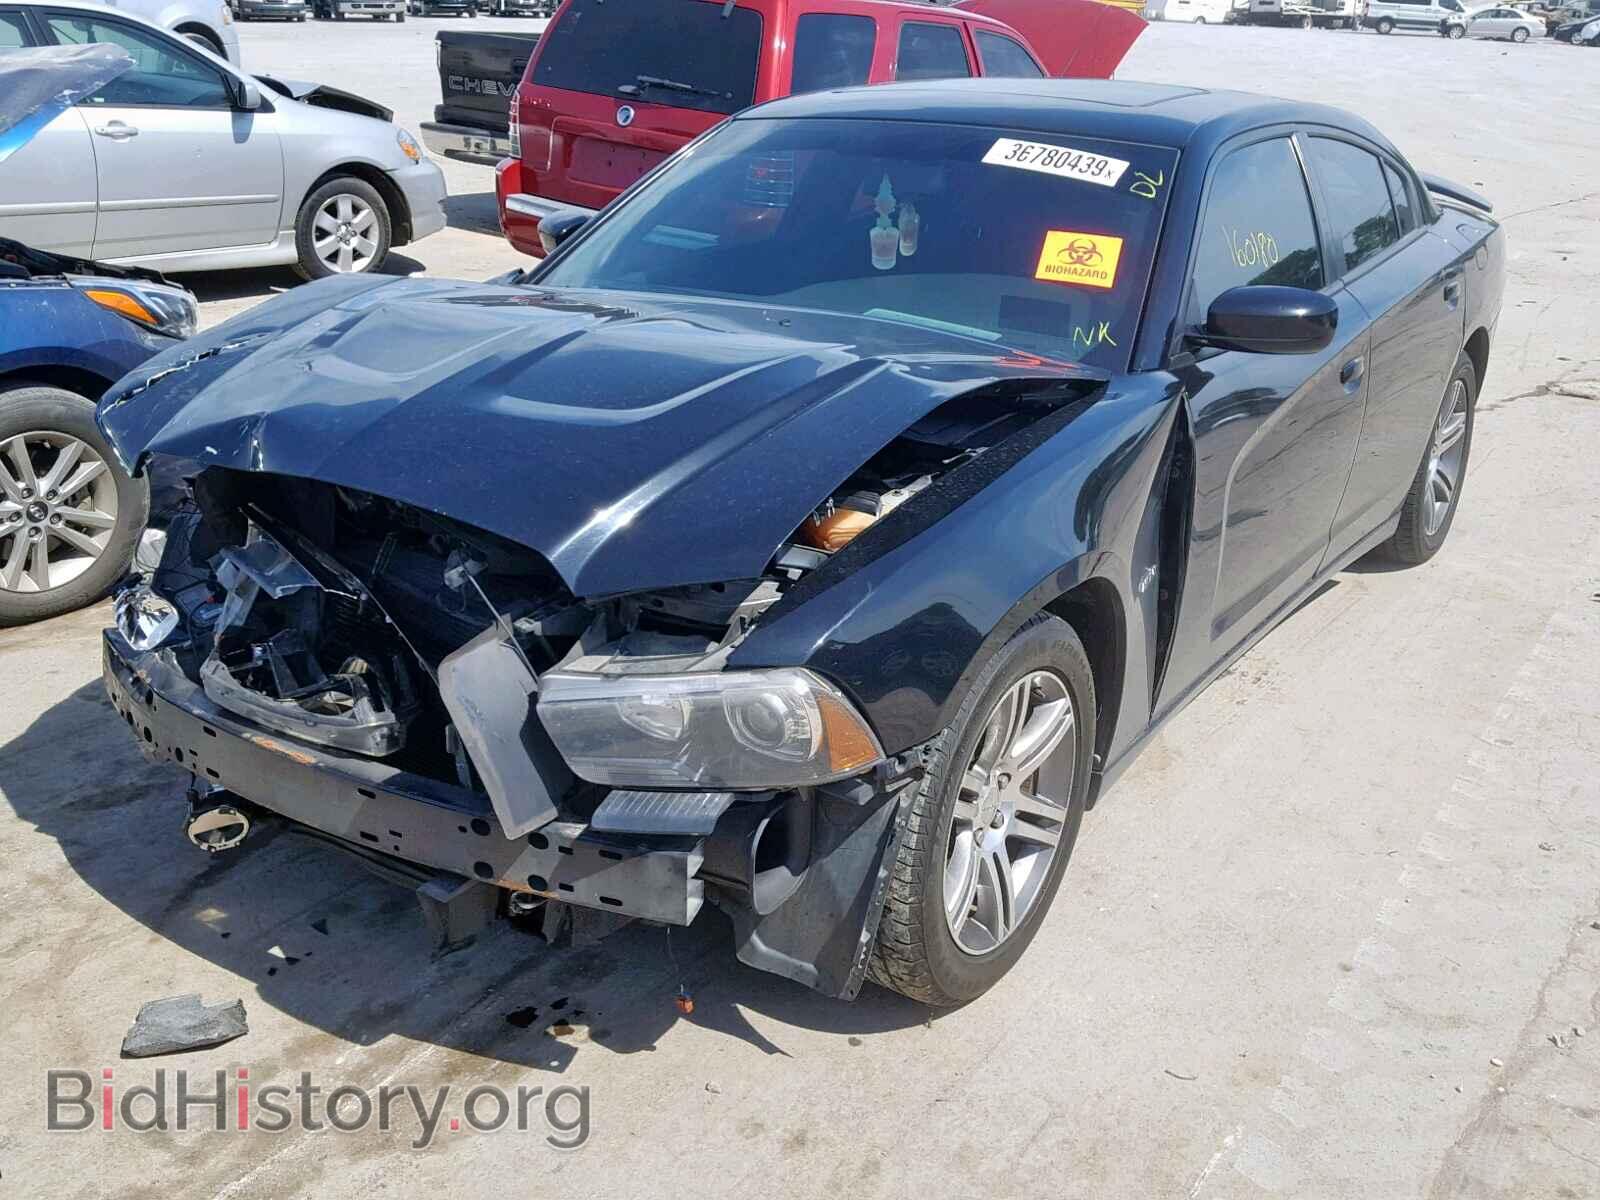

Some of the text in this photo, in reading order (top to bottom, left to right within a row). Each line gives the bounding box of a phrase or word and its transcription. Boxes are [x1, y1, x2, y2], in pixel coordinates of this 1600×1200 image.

[448, 75, 516, 97] CHEV
[1044, 264, 1109, 280] BIOHAZARD
[1072, 320, 1118, 347] NK
